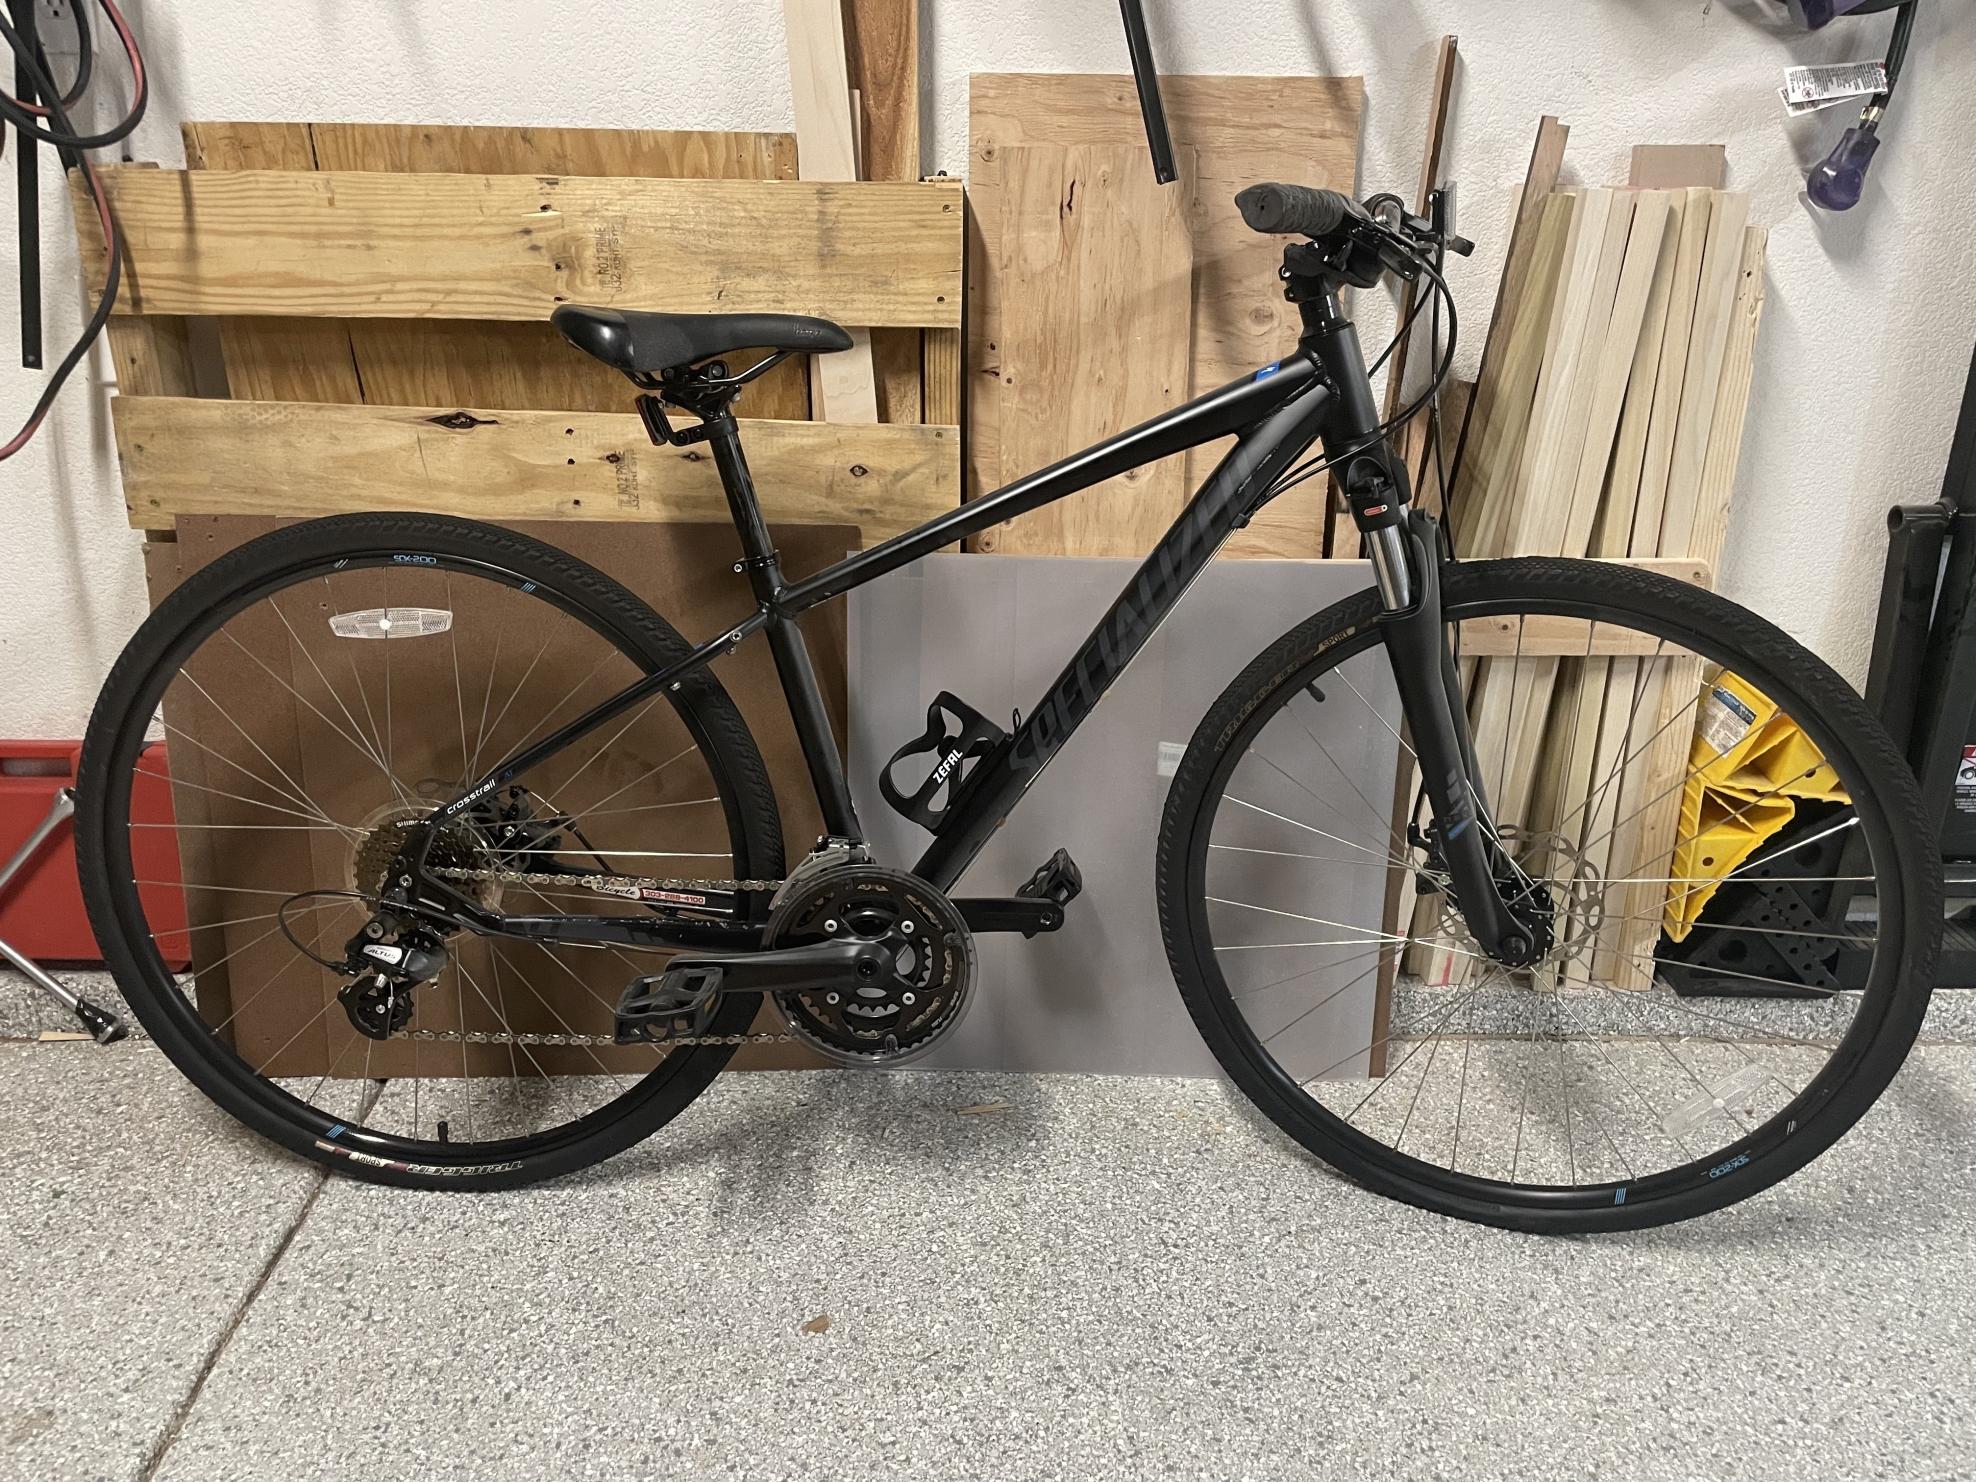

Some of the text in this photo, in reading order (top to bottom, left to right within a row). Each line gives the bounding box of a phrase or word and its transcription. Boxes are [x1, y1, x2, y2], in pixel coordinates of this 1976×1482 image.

[932, 749, 963, 784] ZEFAL
[357, 1152, 523, 1176] TRIGGER SPORT
